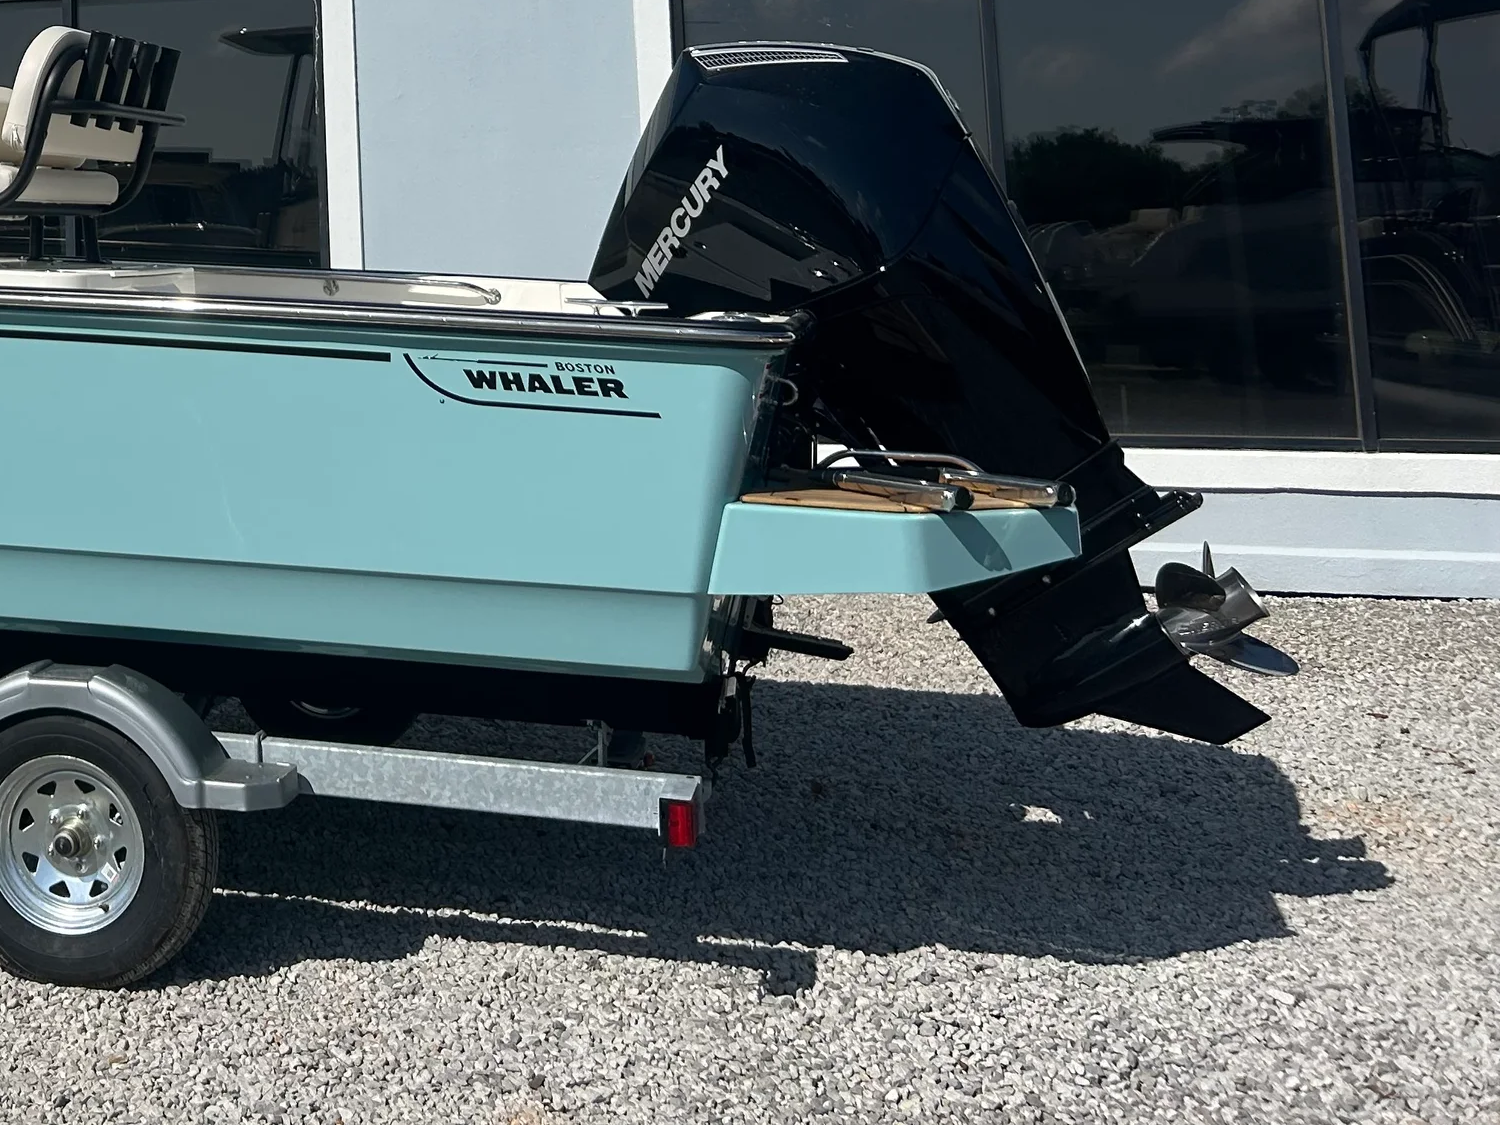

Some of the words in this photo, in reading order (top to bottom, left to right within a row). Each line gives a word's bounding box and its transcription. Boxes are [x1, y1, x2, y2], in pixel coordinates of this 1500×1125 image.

[634, 144, 729, 299] MERCURY
[462, 368, 629, 399] WHALER
[554, 361, 616, 375] BOSTON
